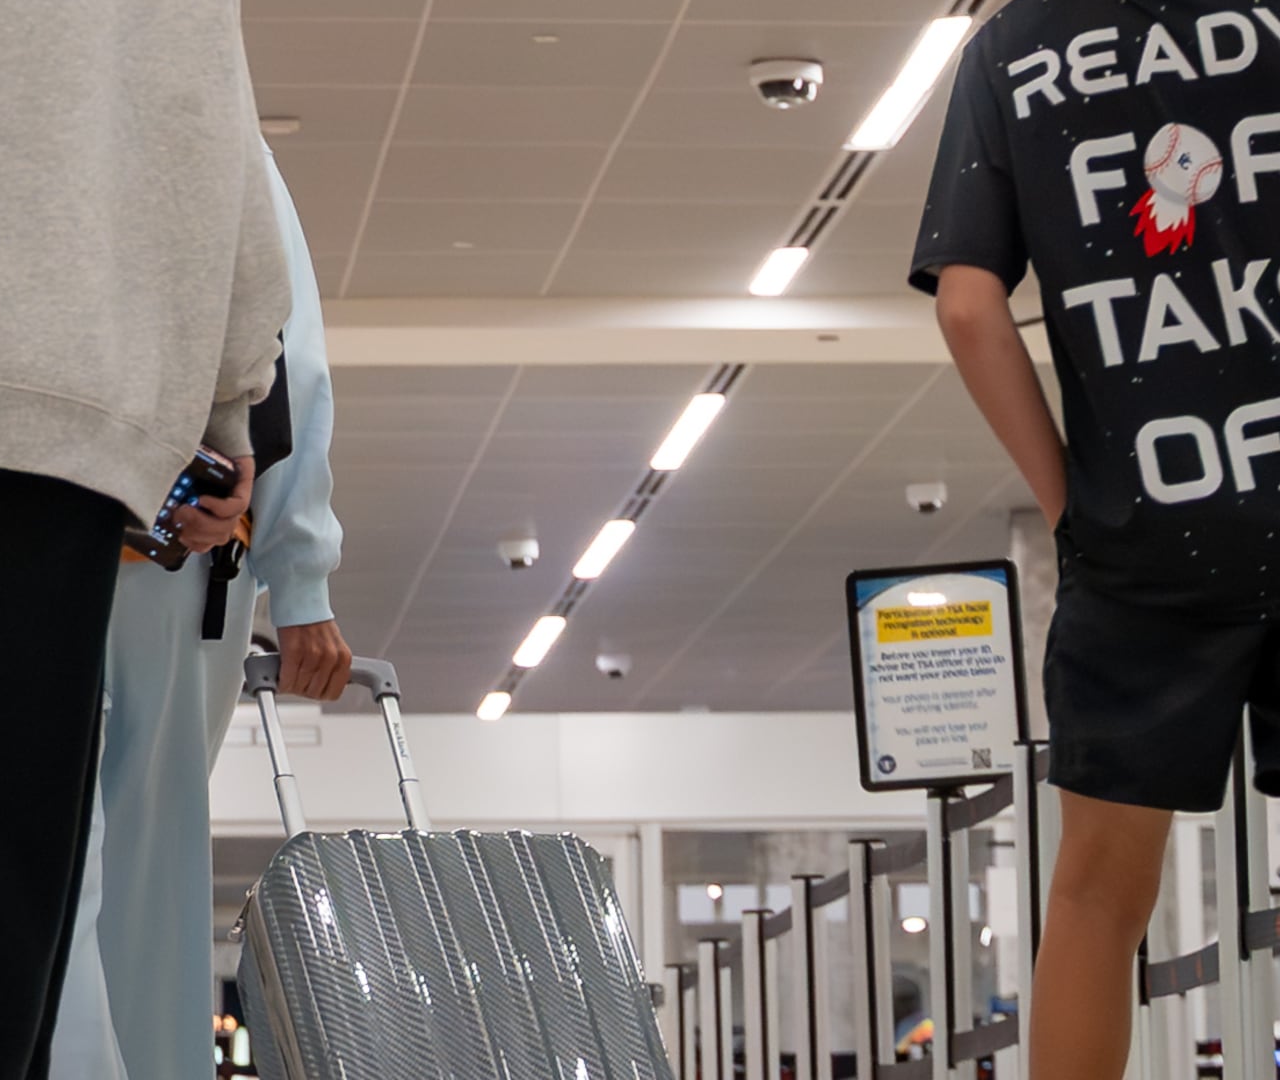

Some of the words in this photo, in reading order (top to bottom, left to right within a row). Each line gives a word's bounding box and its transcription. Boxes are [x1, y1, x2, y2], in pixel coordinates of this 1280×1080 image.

[881, 651, 909, 661] Before
[912, 650, 928, 659] you
[901, 662, 915, 671] the
[918, 660, 934, 669] TSA
[878, 674, 893, 683] not
[895, 672, 918, 681] want
[920, 671, 939, 681] your
[942, 669, 969, 679] photo
